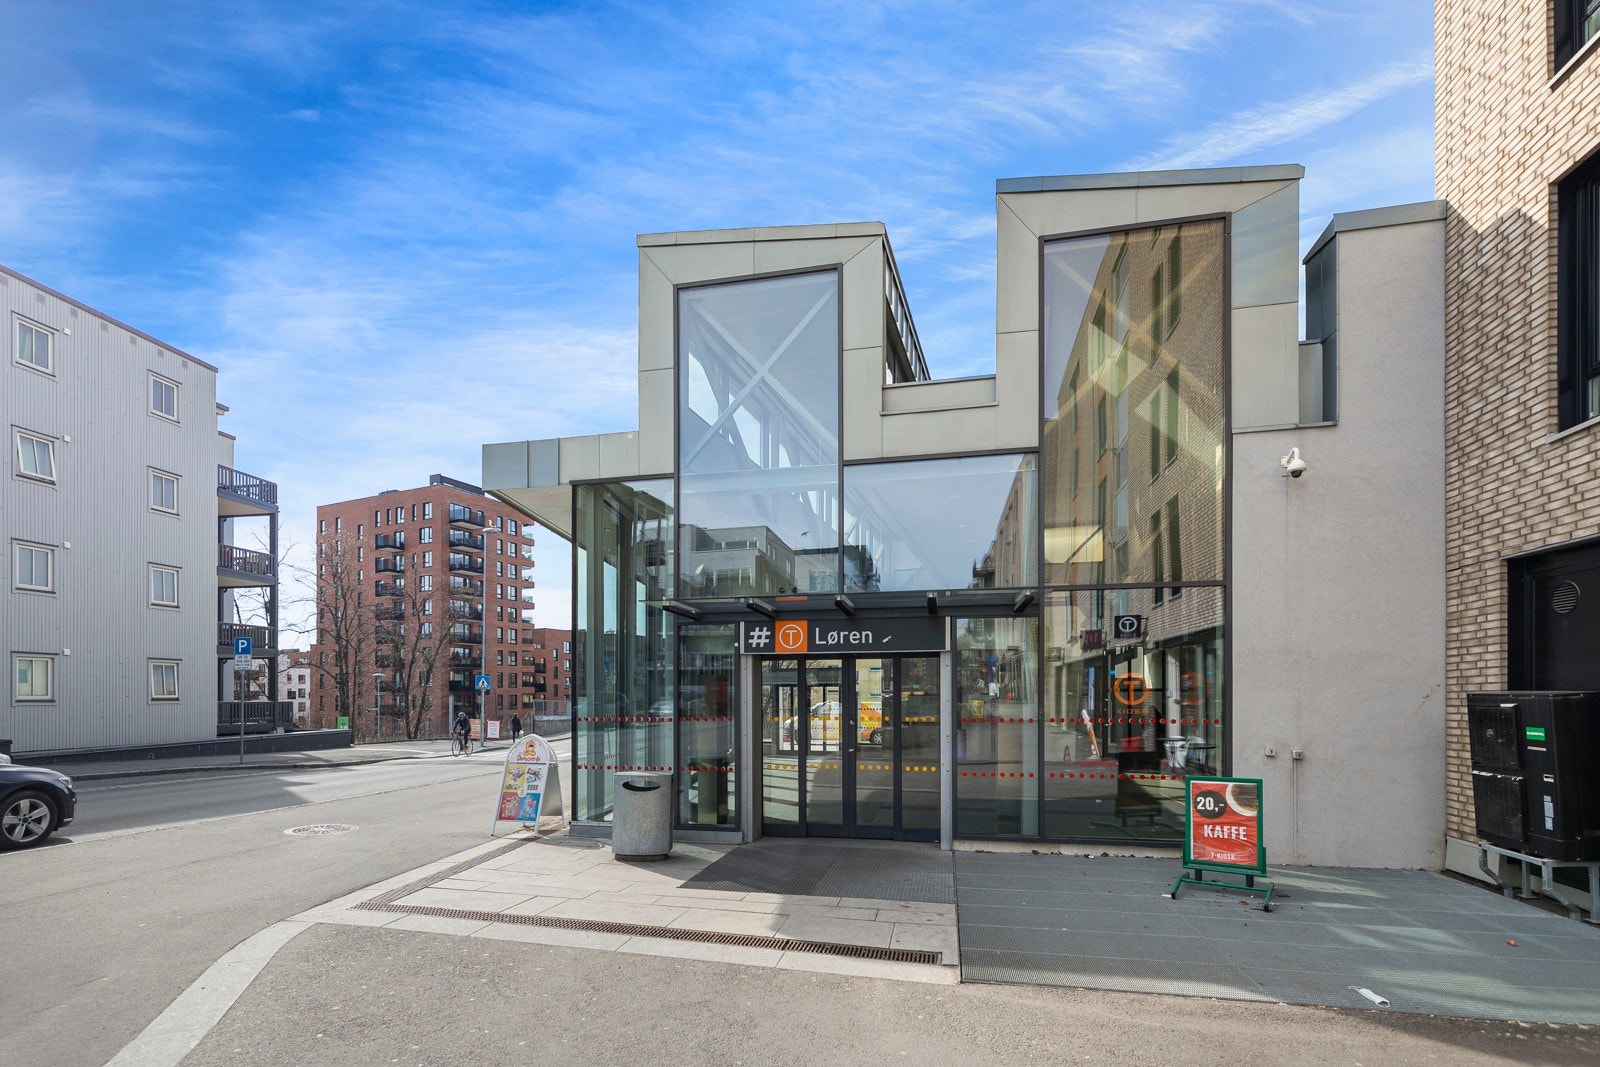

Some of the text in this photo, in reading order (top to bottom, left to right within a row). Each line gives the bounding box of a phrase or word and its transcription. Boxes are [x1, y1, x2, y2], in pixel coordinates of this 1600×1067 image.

[815, 627, 873, 645] Løren
[238, 639, 248, 653] P
[1196, 796, 1225, 812] 20,-
[1203, 824, 1248, 840] KAFFE
[1210, 852, 1236, 860] T-KIOSK
